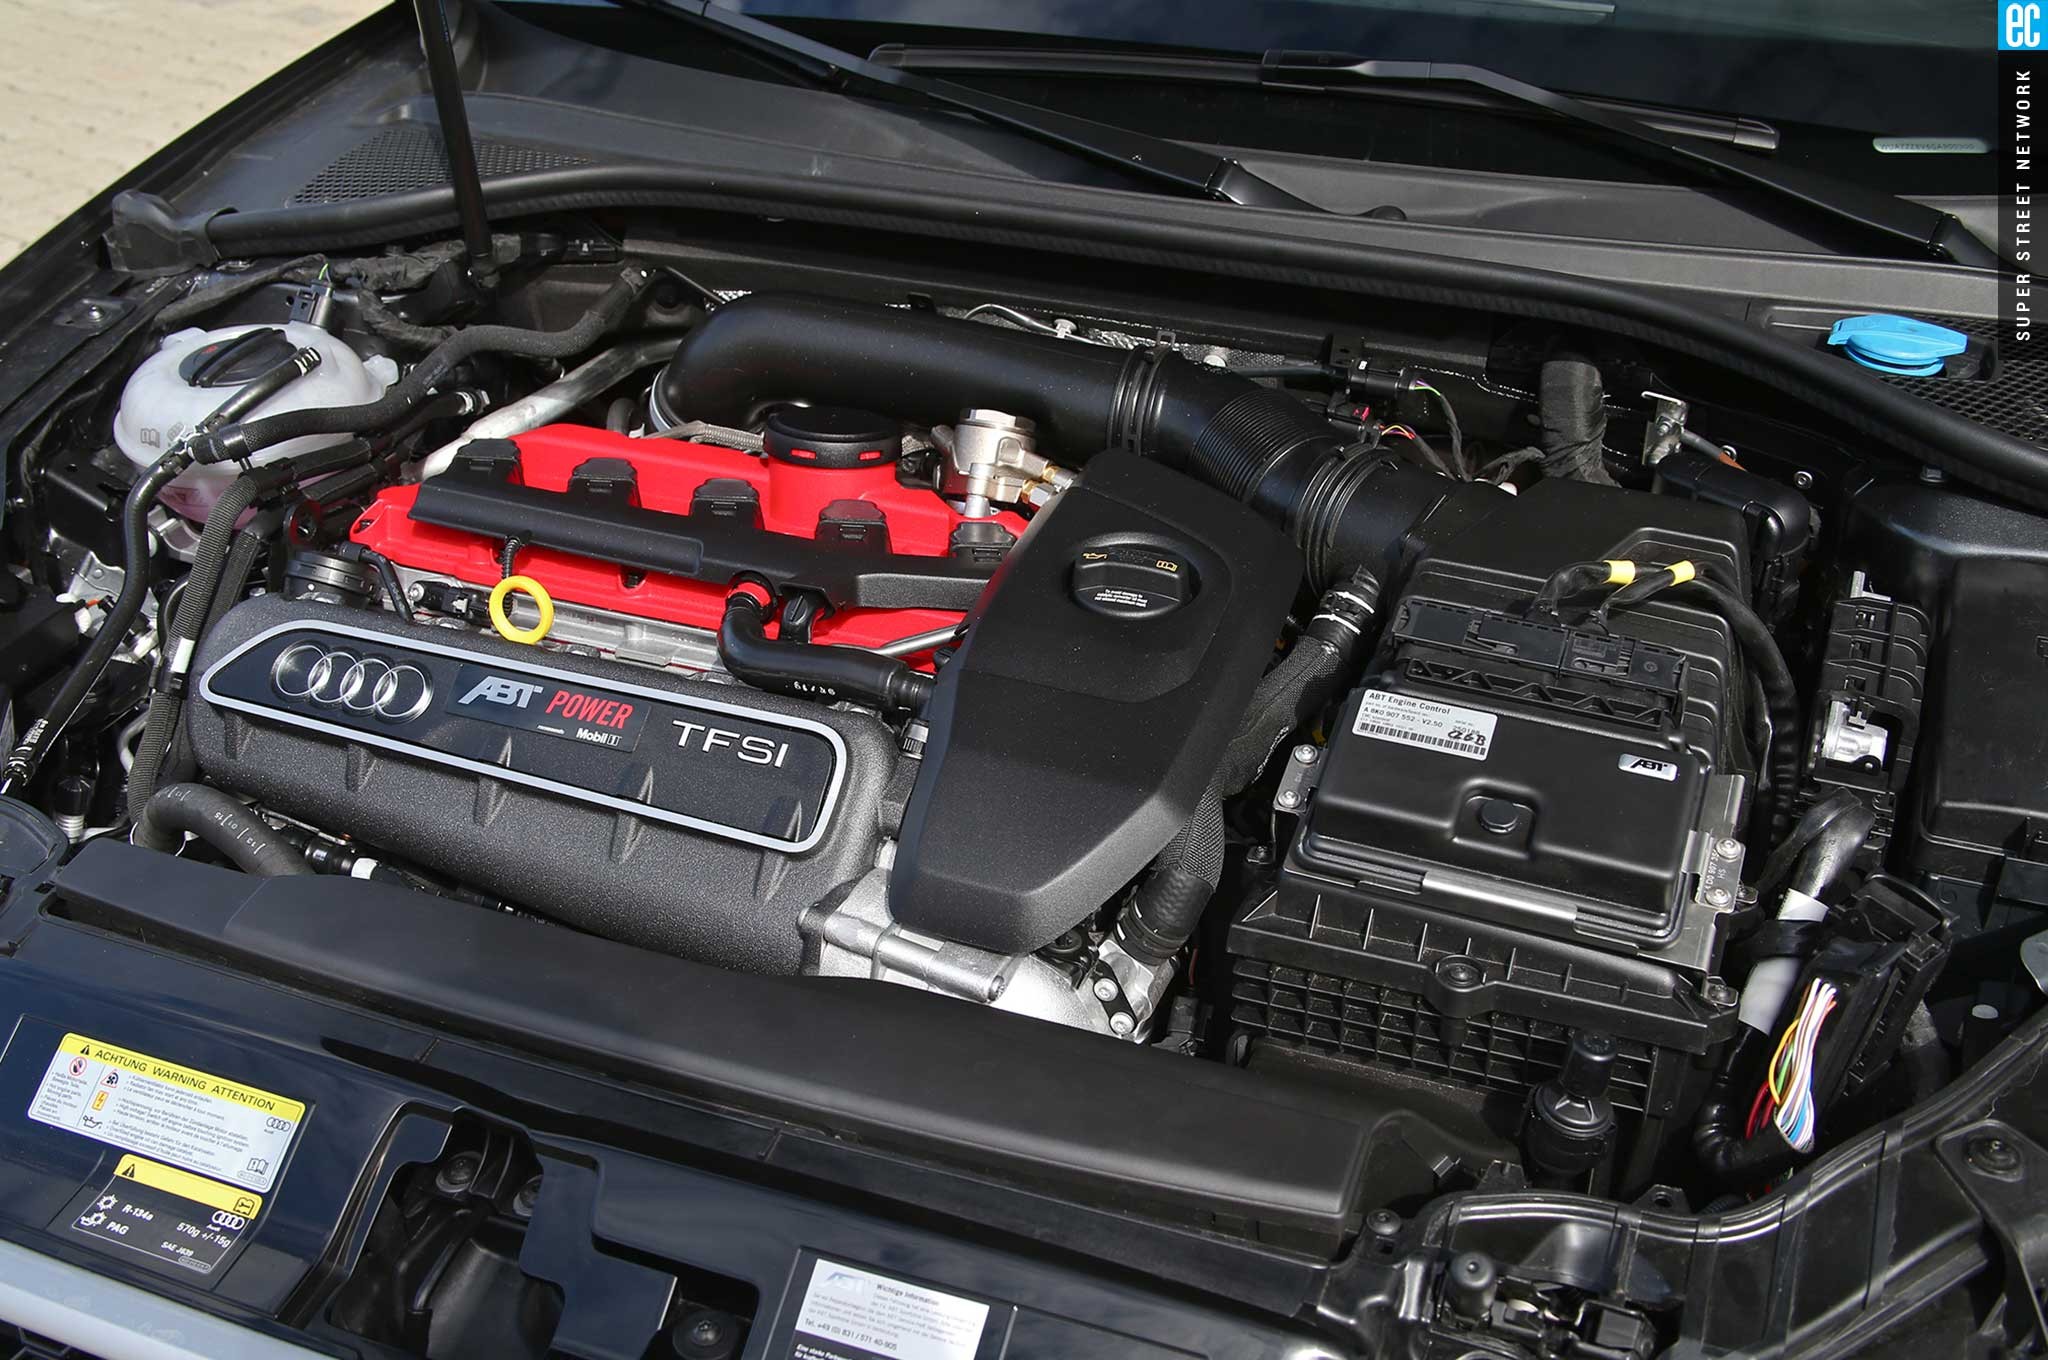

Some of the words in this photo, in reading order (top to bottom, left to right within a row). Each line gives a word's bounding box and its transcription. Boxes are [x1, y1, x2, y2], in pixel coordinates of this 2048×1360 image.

[458, 676, 544, 708] ABT
[545, 690, 634, 729] POWER
[1388, 696, 1416, 707] Engine
[1420, 702, 1450, 715] Control
[1422, 718, 1443, 727] V2.50
[576, 728, 607, 744] Mobil
[672, 720, 789, 768] TFSI
[1630, 759, 1668, 771] ABT
[94, 1049, 148, 1072] ACHTUNG
[153, 1067, 207, 1090] WARNING
[211, 1086, 276, 1111] ATTENTION
[122, 1204, 154, 1221] R-134a
[106, 1221, 129, 1235] PAG
[176, 1222, 201, 1238] 570g
[201, 1232, 231, 1248] +/-15g
[161, 1241, 176, 1251] SAE
